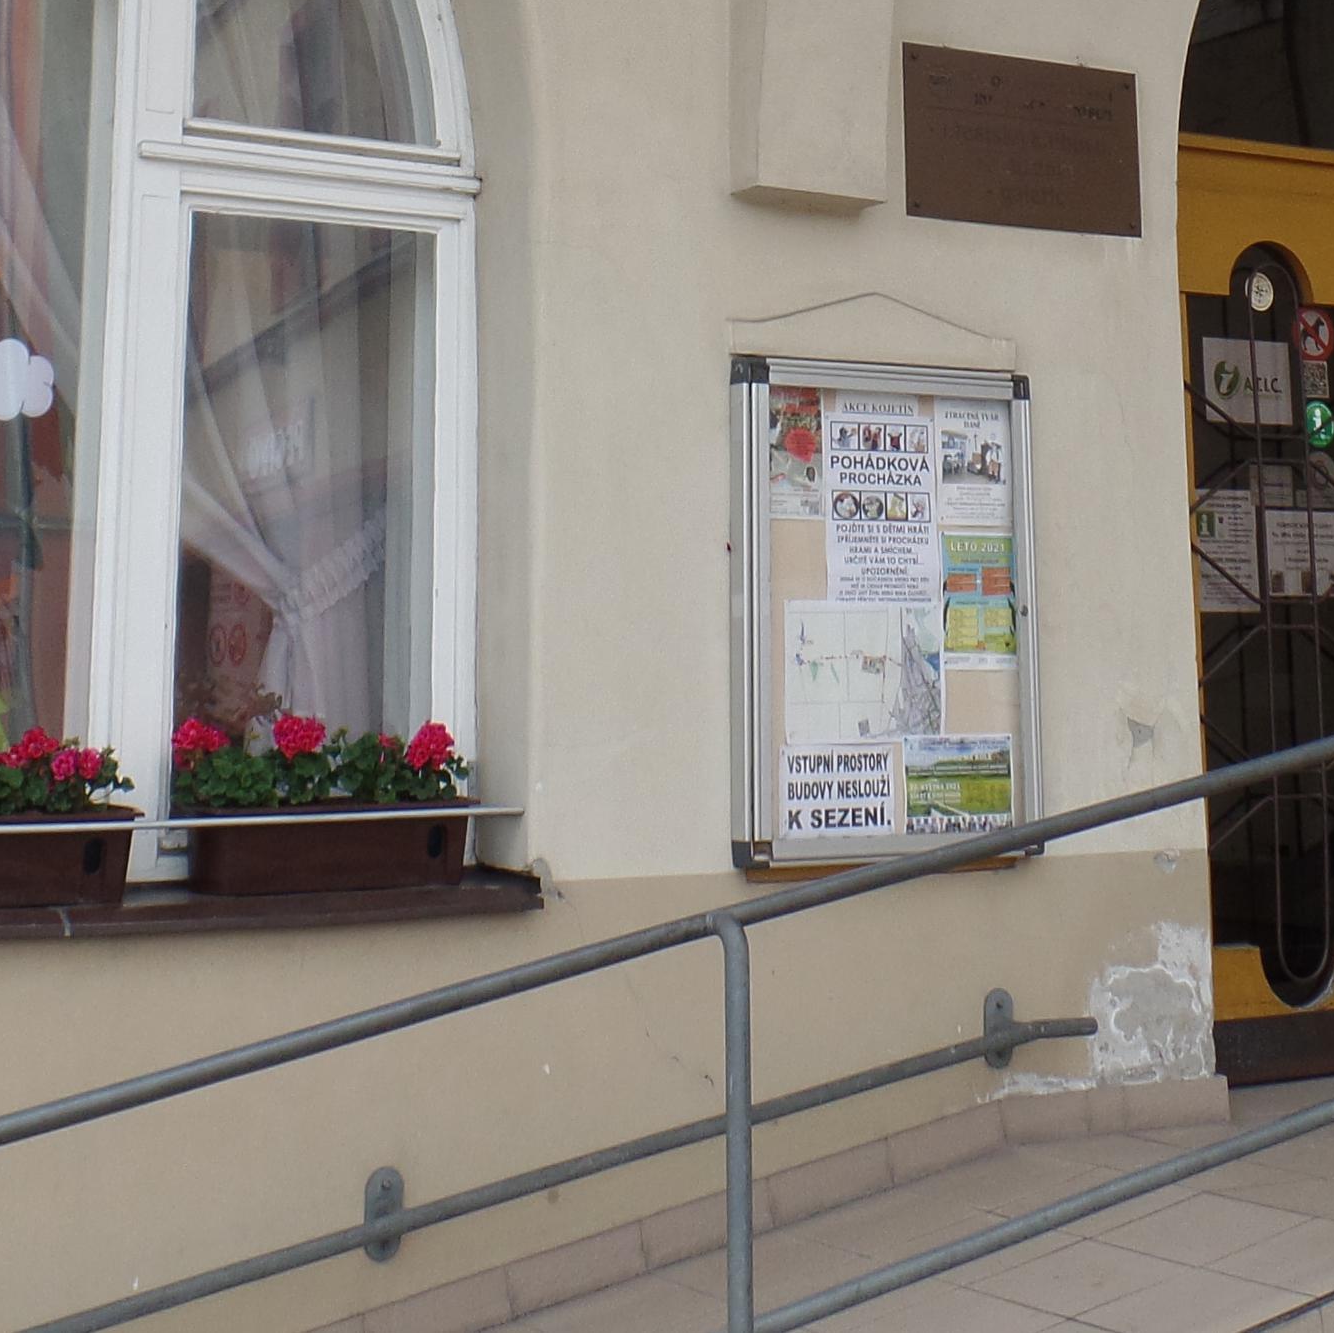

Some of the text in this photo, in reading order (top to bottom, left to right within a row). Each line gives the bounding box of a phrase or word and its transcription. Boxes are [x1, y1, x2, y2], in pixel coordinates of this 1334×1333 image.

[843, 402, 914, 414] AKCE KOJETÍN
[830, 453, 930, 473] POHÁDKOVÁ
[839, 471, 922, 487] PROCHÁZKA
[836, 523, 865, 533] POJĎTE
[867, 524, 874, 533] SI
[876, 524, 881, 533] S
[888, 536, 929, 545] PROCHÁZKU
[981, 543, 1005, 553] 2021
[787, 749, 888, 774] VSTUPNÍ PROSTORY
[788, 780, 834, 800] BUDOVY
[837, 774, 890, 799] NESLOUŽÍ
[788, 801, 892, 830] K SEZENÍ.
